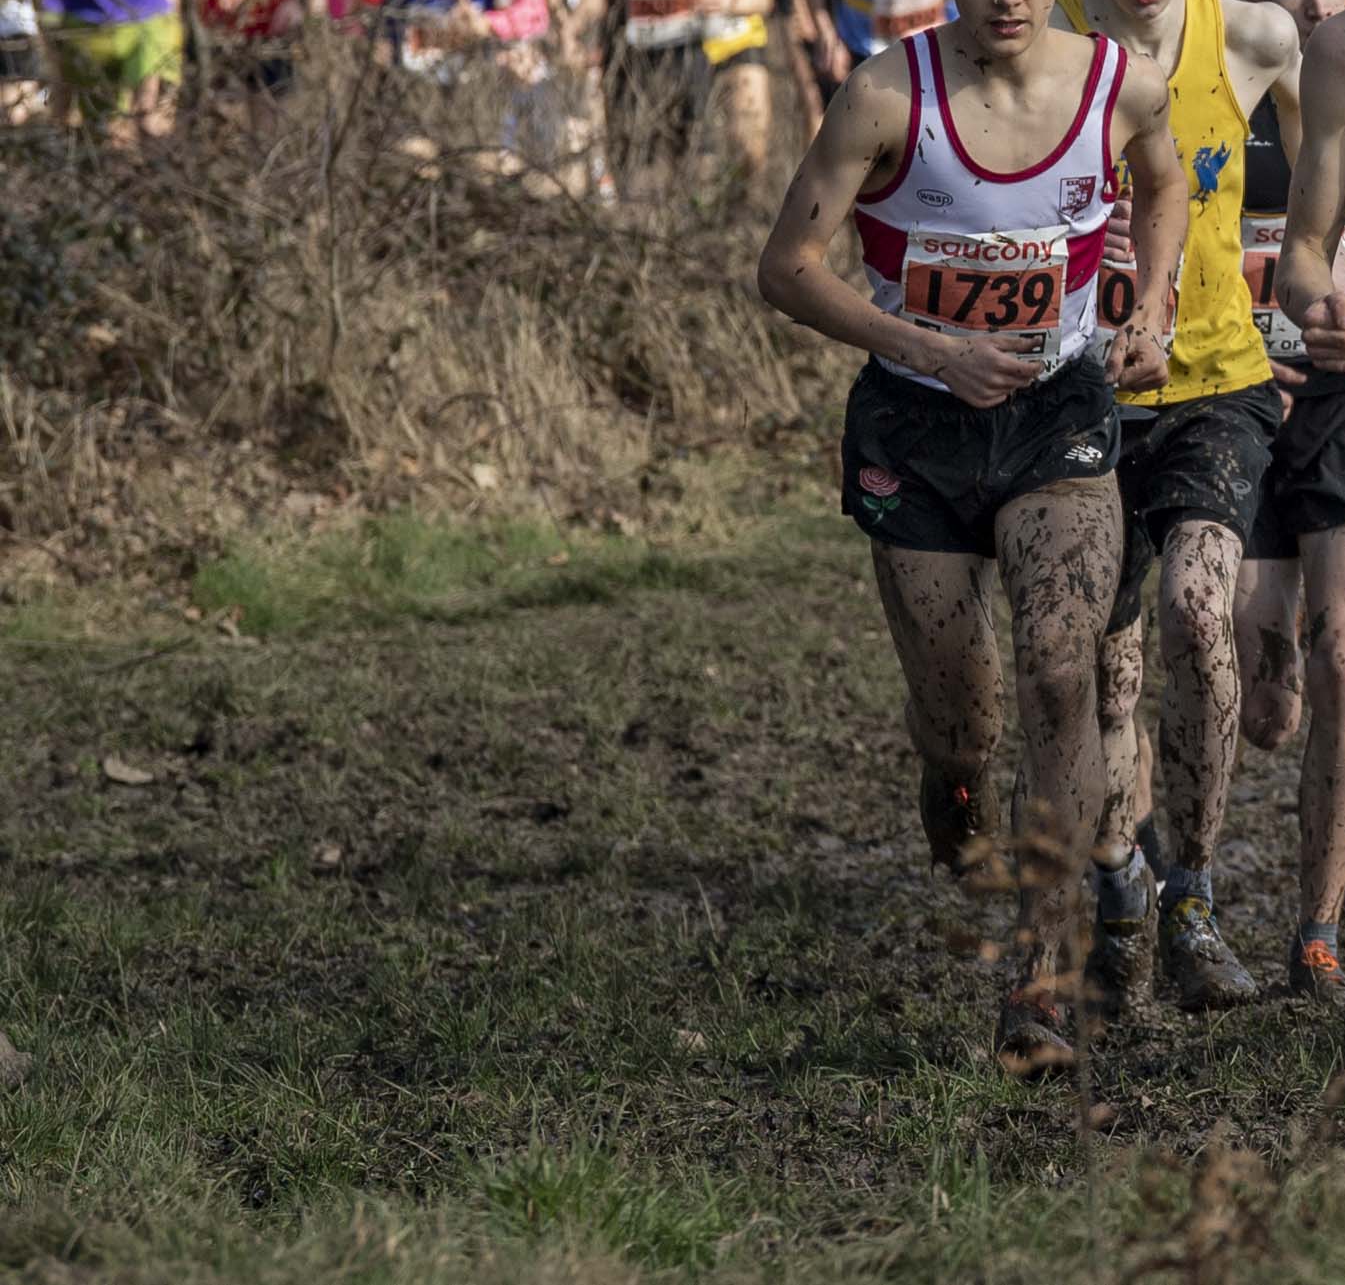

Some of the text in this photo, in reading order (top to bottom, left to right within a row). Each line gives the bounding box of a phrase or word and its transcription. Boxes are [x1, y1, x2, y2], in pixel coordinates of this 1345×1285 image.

[918, 191, 951, 206] wasp
[924, 237, 1054, 263] saucony
[927, 270, 1054, 327] 1739
